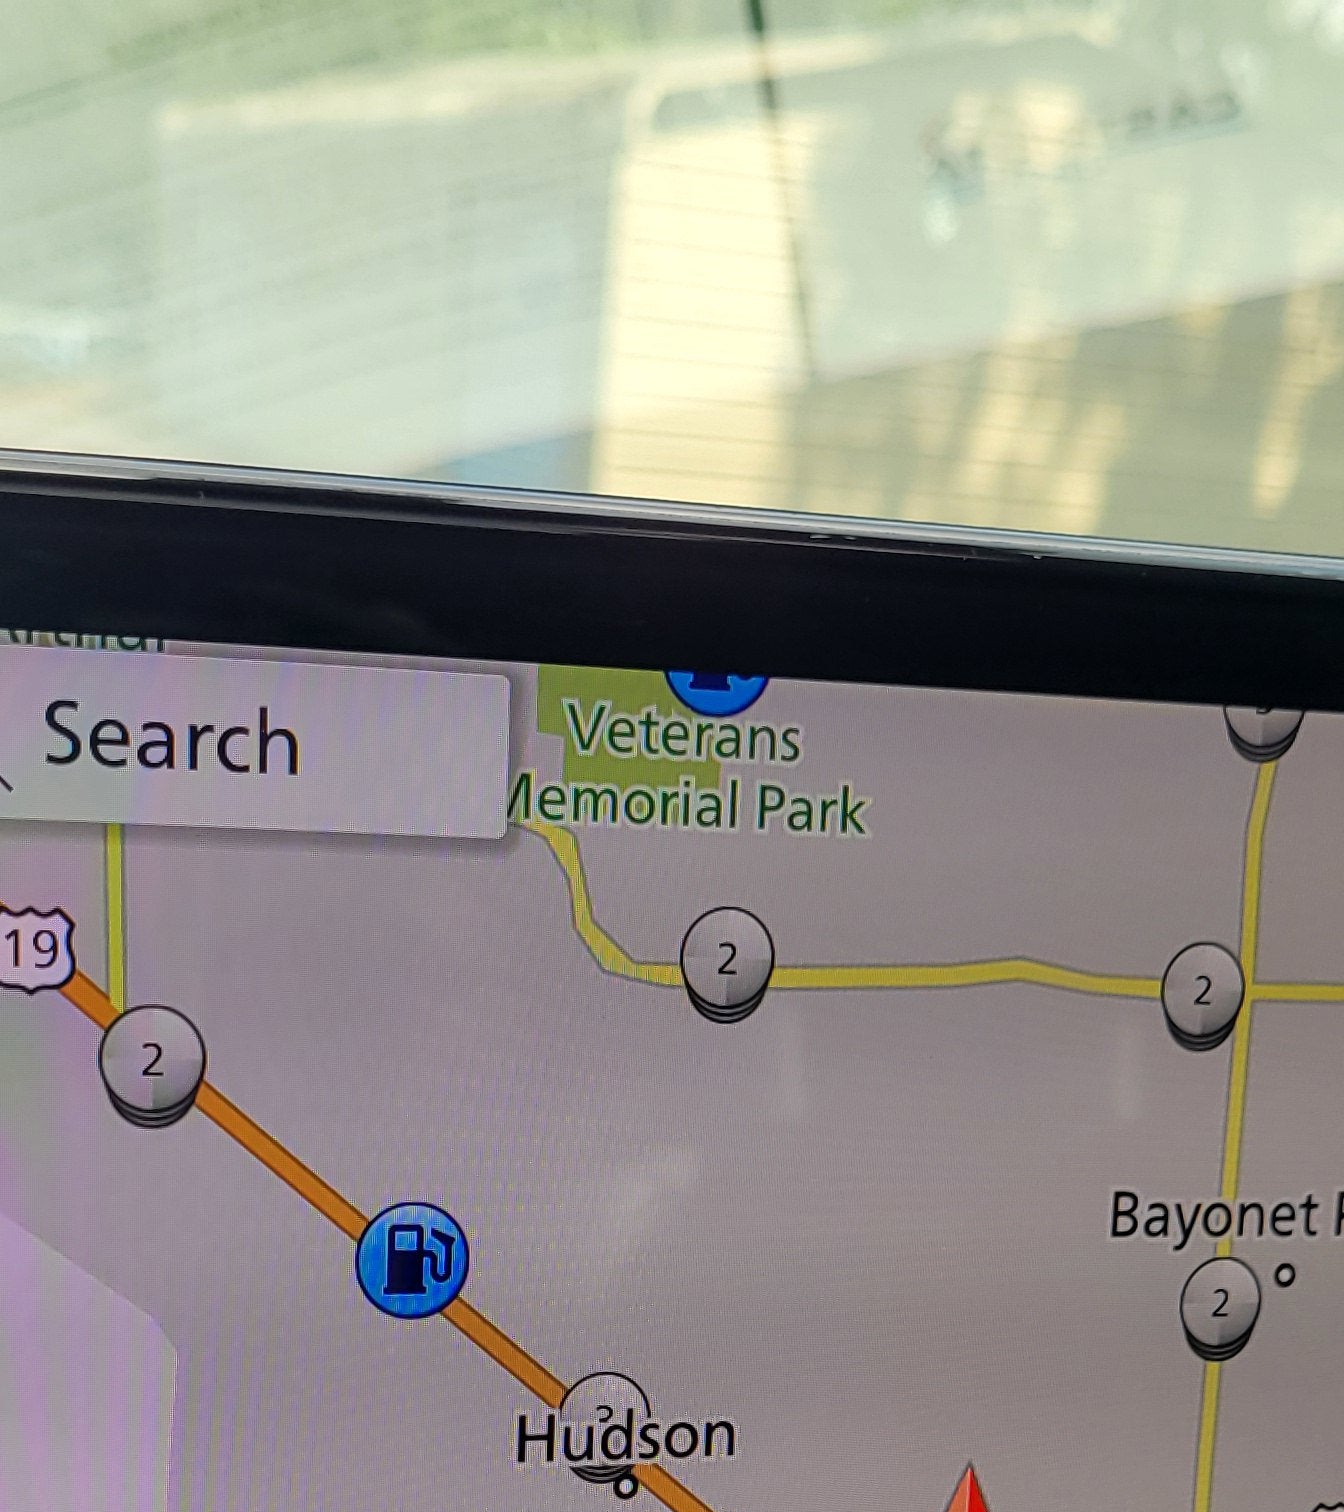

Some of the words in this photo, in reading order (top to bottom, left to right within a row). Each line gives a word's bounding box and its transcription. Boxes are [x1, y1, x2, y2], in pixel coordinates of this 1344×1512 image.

[44, 699, 300, 776] Search
[565, 702, 802, 764] Veterans
[508, 771, 740, 829] Memorial
[756, 782, 867, 836] Park
[3, 929, 58, 970] 19
[717, 943, 738, 976] 2
[1193, 975, 1214, 1006] 2
[141, 1043, 165, 1078] 2
[1109, 1190, 1320, 1253] Bayonet
[1211, 1288, 1230, 1318] 2
[517, 1407, 736, 1464] Hudson
